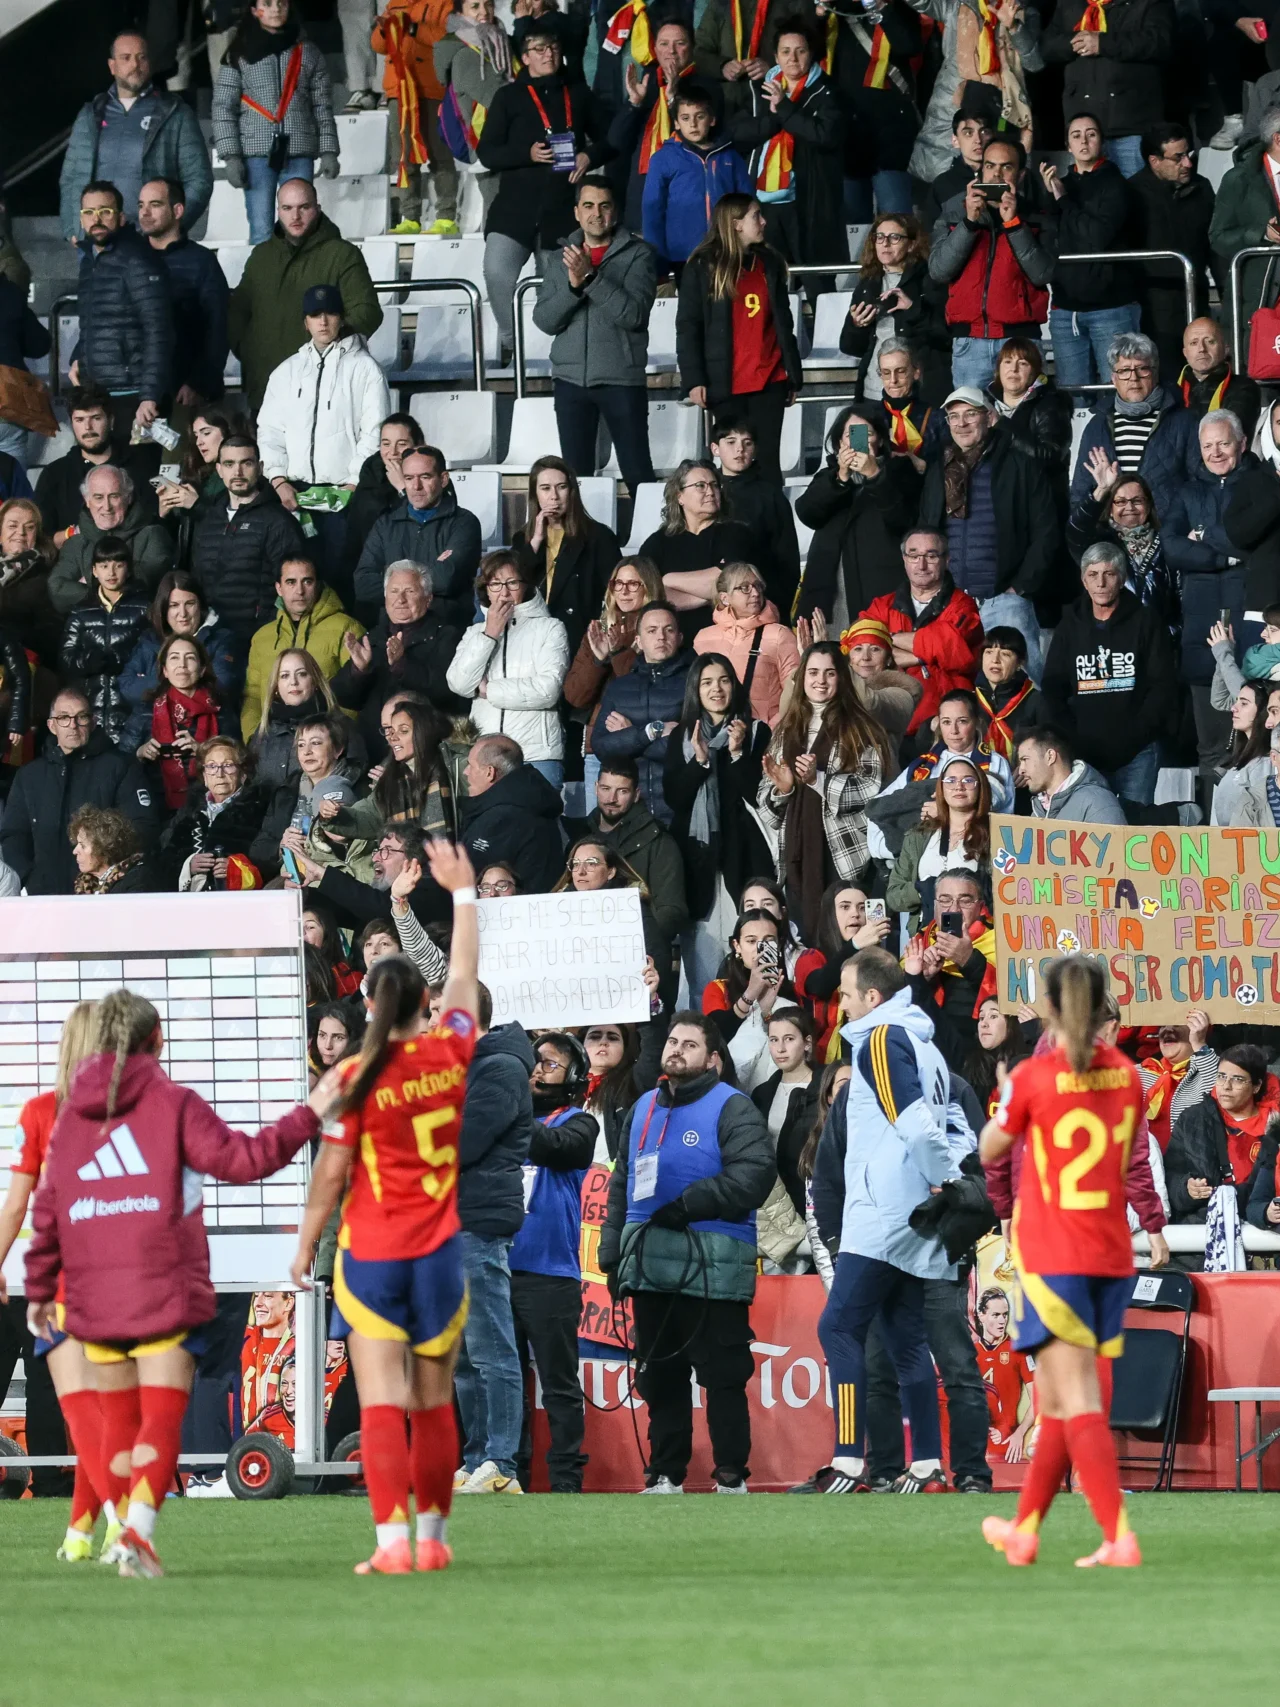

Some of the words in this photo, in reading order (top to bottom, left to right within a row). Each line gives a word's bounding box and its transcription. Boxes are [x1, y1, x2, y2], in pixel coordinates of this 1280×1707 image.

[745, 293, 760, 318] 9
[1076, 655, 1095, 667] AU
[1112, 652, 1135, 665] 20
[1077, 667, 1097, 680] NZ
[1112, 664, 1136, 678] 23
[994, 849, 1016, 874] 30
[1000, 826, 1115, 875] VICKY,
[1124, 831, 1209, 877] CON
[1003, 913, 1058, 952] UNA
[1075, 908, 1144, 951] NIÑA
[479, 941, 532, 971] TENER
[534, 938, 558, 968] TU
[562, 933, 645, 966] CAMISETA
[1110, 953, 1163, 1006] SER
[1170, 954, 1243, 1002] COMO
[376, 1086, 401, 1111] M.
[402, 1063, 467, 1104] MÉNDE
[1055, 1066, 1131, 1095] REDONDO
[411, 1105, 457, 1201] 5
[1052, 1105, 1136, 1210] 21
